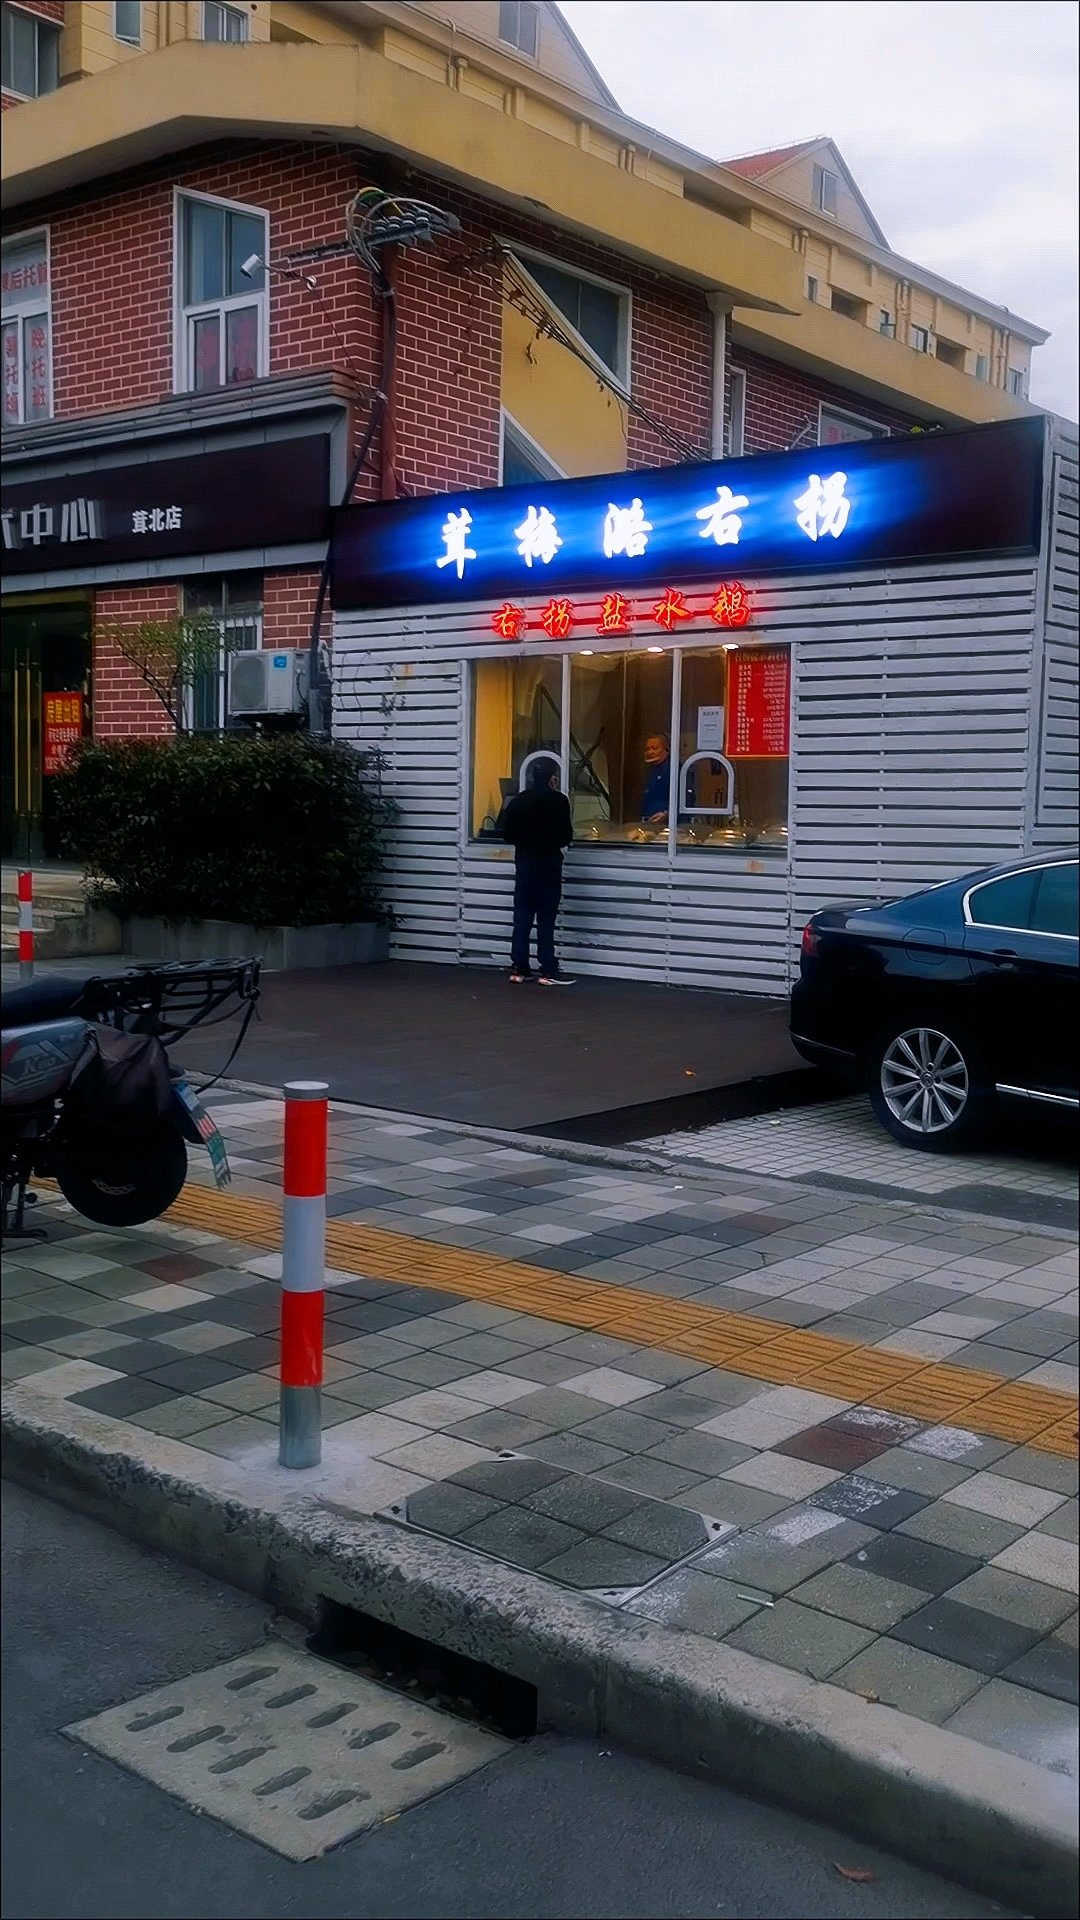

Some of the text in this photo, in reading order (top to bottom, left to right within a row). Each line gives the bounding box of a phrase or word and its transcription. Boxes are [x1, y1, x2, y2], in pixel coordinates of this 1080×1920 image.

[131, 505, 183, 534] 茸北店
[491, 580, 752, 640] 右拐盐水鹅
[46, 698, 81, 724] 房屋出租
